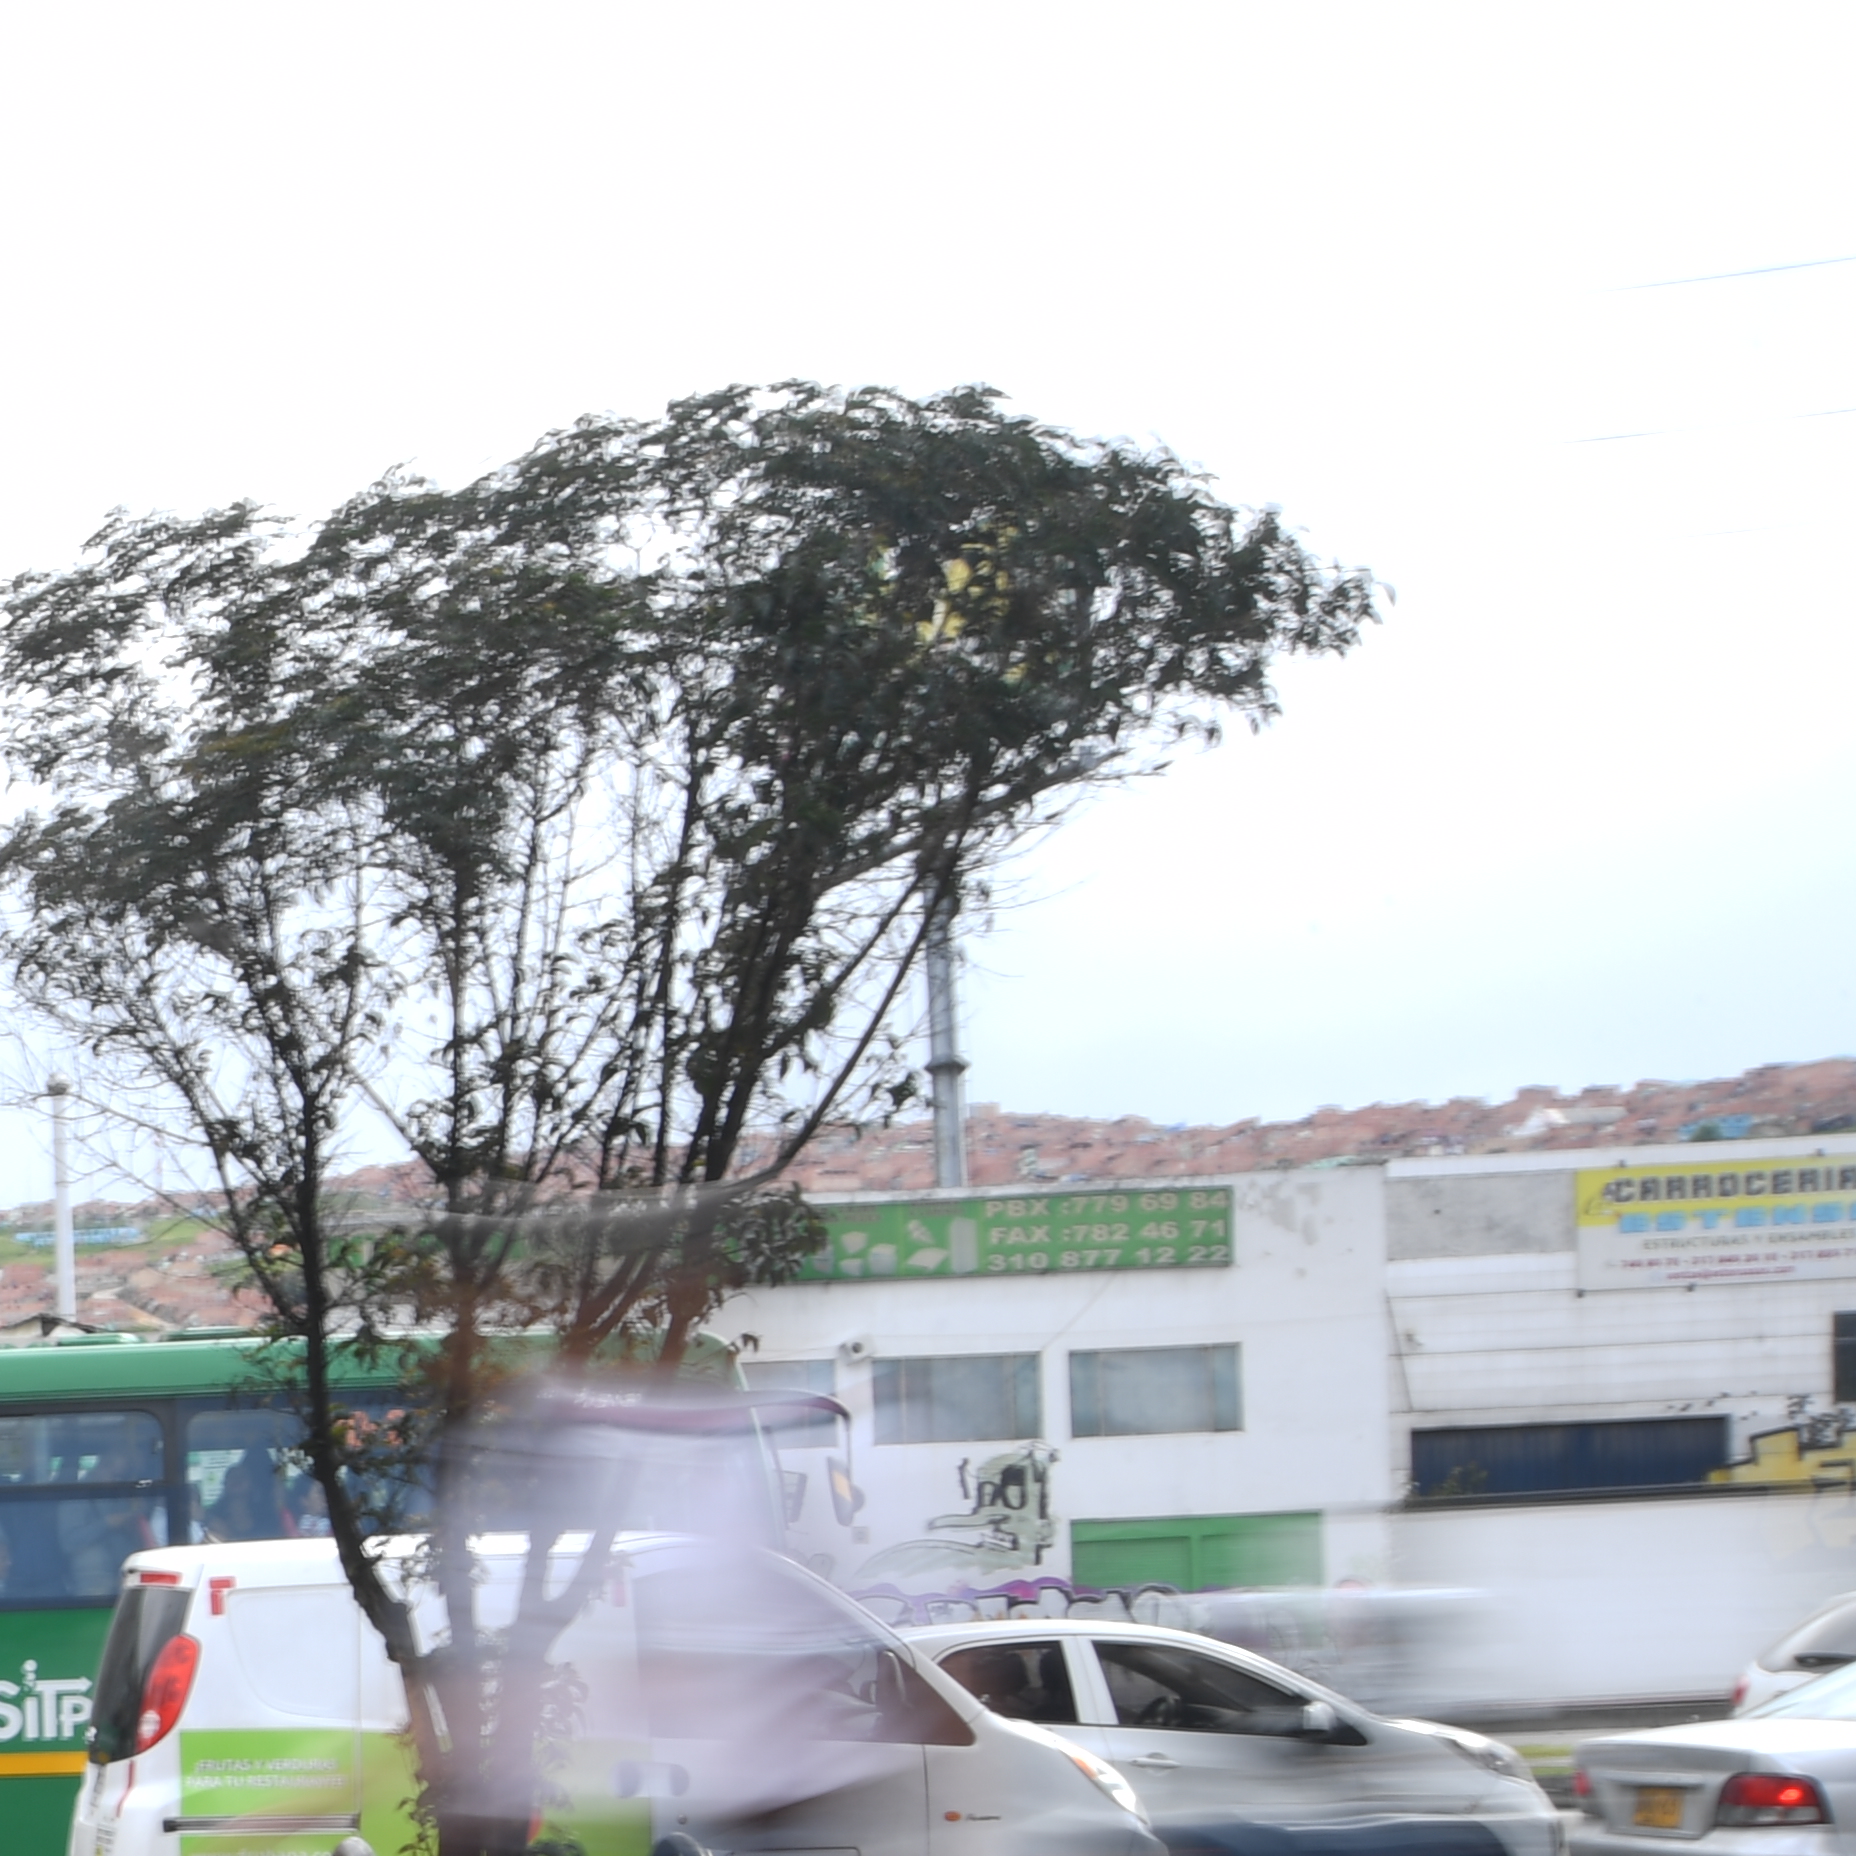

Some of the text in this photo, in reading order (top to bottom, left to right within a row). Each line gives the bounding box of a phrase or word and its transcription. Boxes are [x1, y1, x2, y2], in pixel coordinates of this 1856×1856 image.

[985, 1199, 1049, 1219] PBX
[1139, 1193, 1179, 1211] 69
[1189, 1191, 1228, 1210] 84
[990, 1225, 1051, 1245] FAX
[1138, 1221, 1179, 1240] 46
[1190, 1219, 1227, 1239] 71
[988, 1244, 1229, 1271] 310 877 12 22
